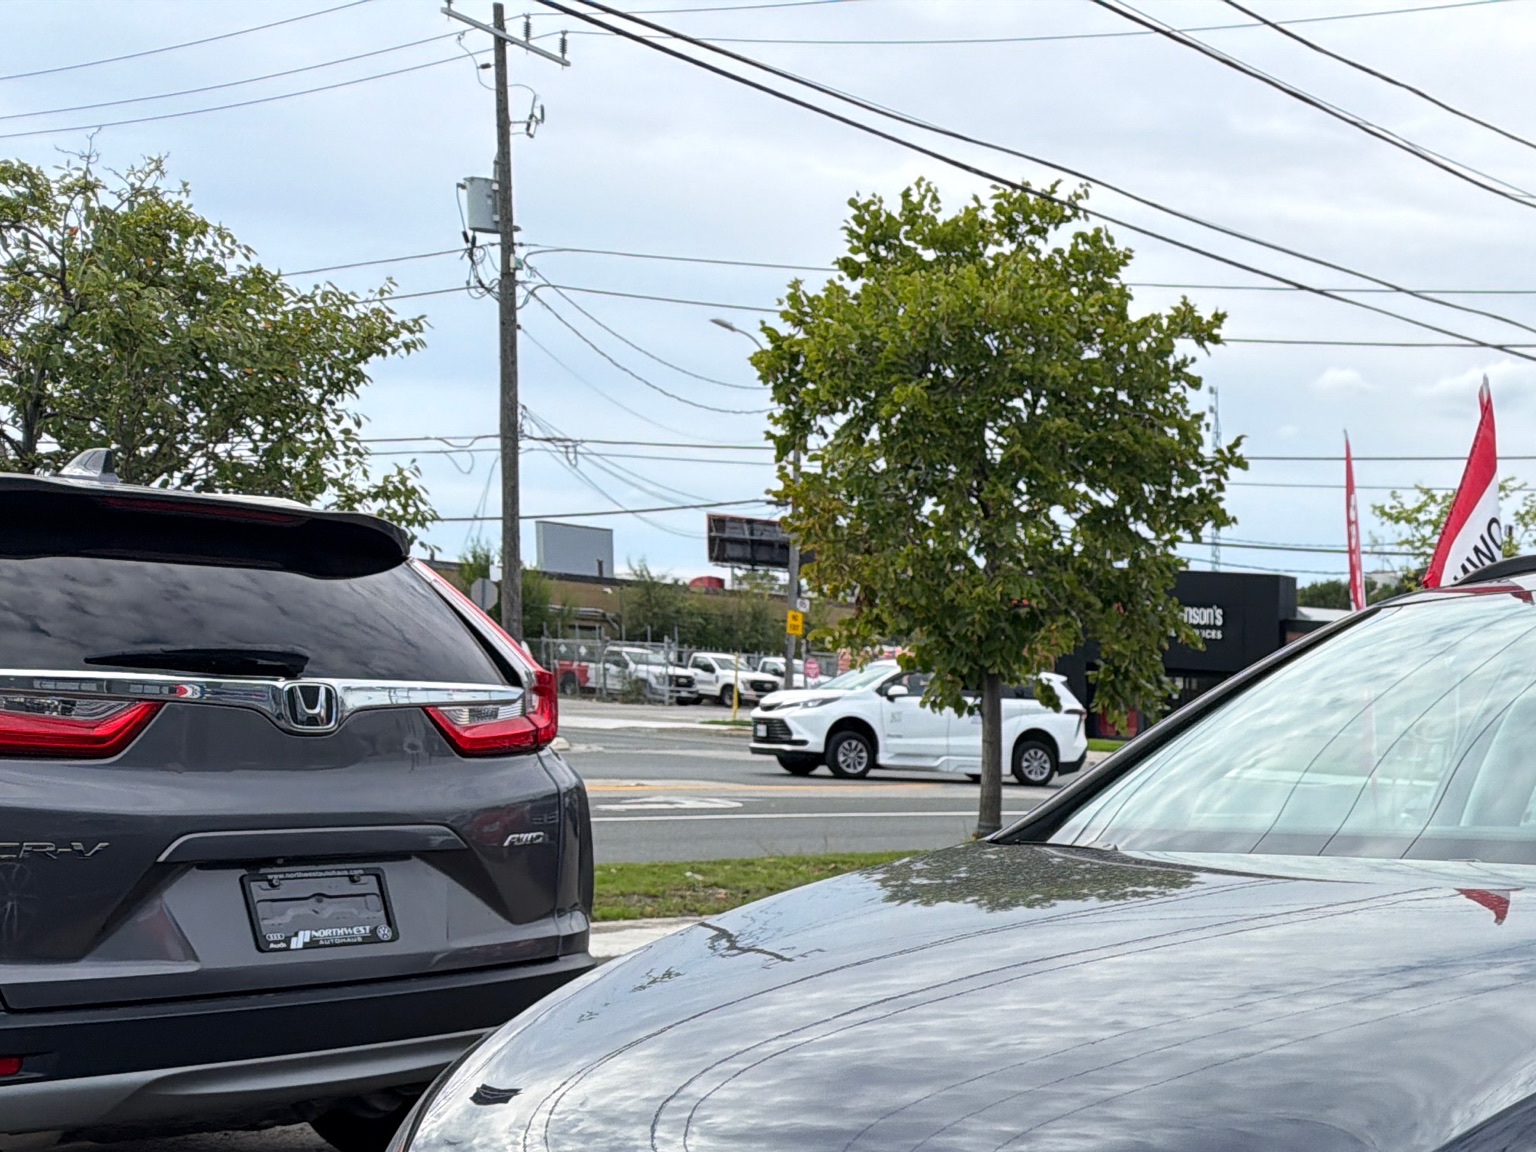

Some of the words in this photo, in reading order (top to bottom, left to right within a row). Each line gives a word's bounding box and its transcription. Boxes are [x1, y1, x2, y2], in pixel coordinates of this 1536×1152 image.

[1183, 605, 1223, 626] nson's
[312, 926, 371, 937] NORTHWEST
[319, 937, 363, 945] AUTOHAUS
